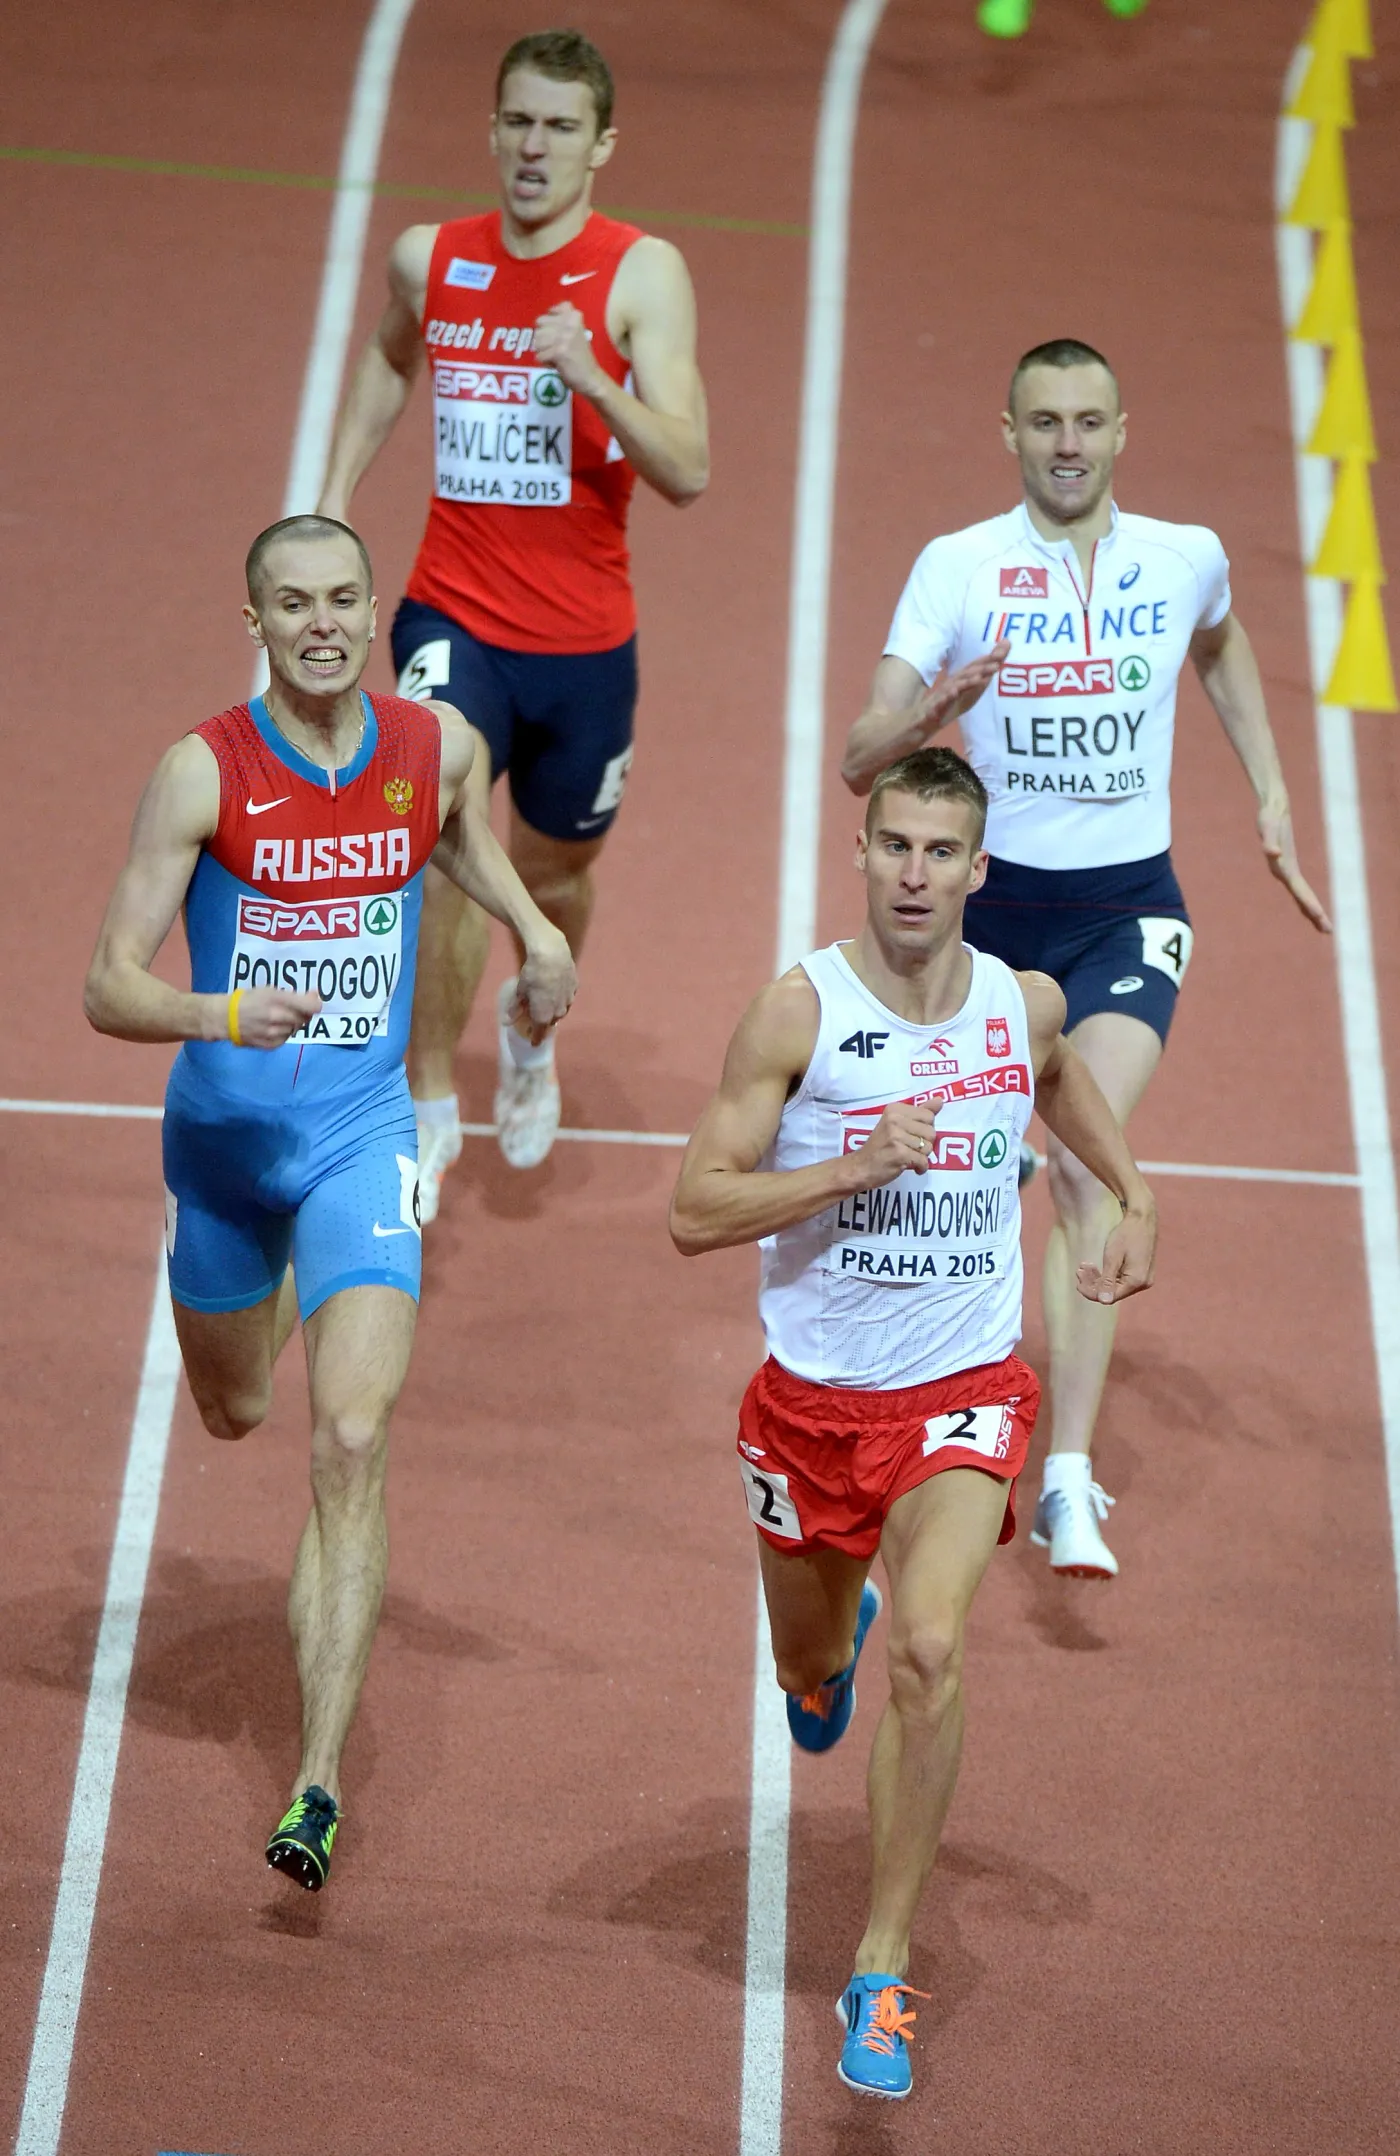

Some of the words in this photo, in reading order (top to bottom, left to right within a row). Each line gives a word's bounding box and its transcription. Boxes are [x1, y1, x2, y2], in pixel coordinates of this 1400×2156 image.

[425, 317, 485, 350] czech
[436, 368, 528, 402] SPAR
[439, 413, 564, 464] PAVLÍČEK
[440, 474, 504, 496] PRAHA
[513, 480, 561, 500] 2015
[1003, 586, 1046, 596] AREVA
[1002, 600, 1168, 644] FRANCE
[1000, 663, 1113, 695] SPAR
[1003, 710, 1147, 758] LEROY
[1007, 771, 1096, 793] PRAHA
[1105, 768, 1146, 793] 2015
[251, 828, 411, 882] RUSSIA
[243, 906, 357, 936] SPAR
[1161, 932, 1182, 972] 4
[234, 952, 397, 1002] POISTOGOV
[838, 1030, 890, 1058] 4F
[912, 1062, 957, 1075] ORLEN
[837, 1187, 1001, 1238] LEWANDOWSKI
[841, 1248, 938, 1277] PRAHA
[946, 1251, 996, 1277] 2015
[942, 1407, 977, 1441] 2
[752, 1473, 783, 1527] 2
